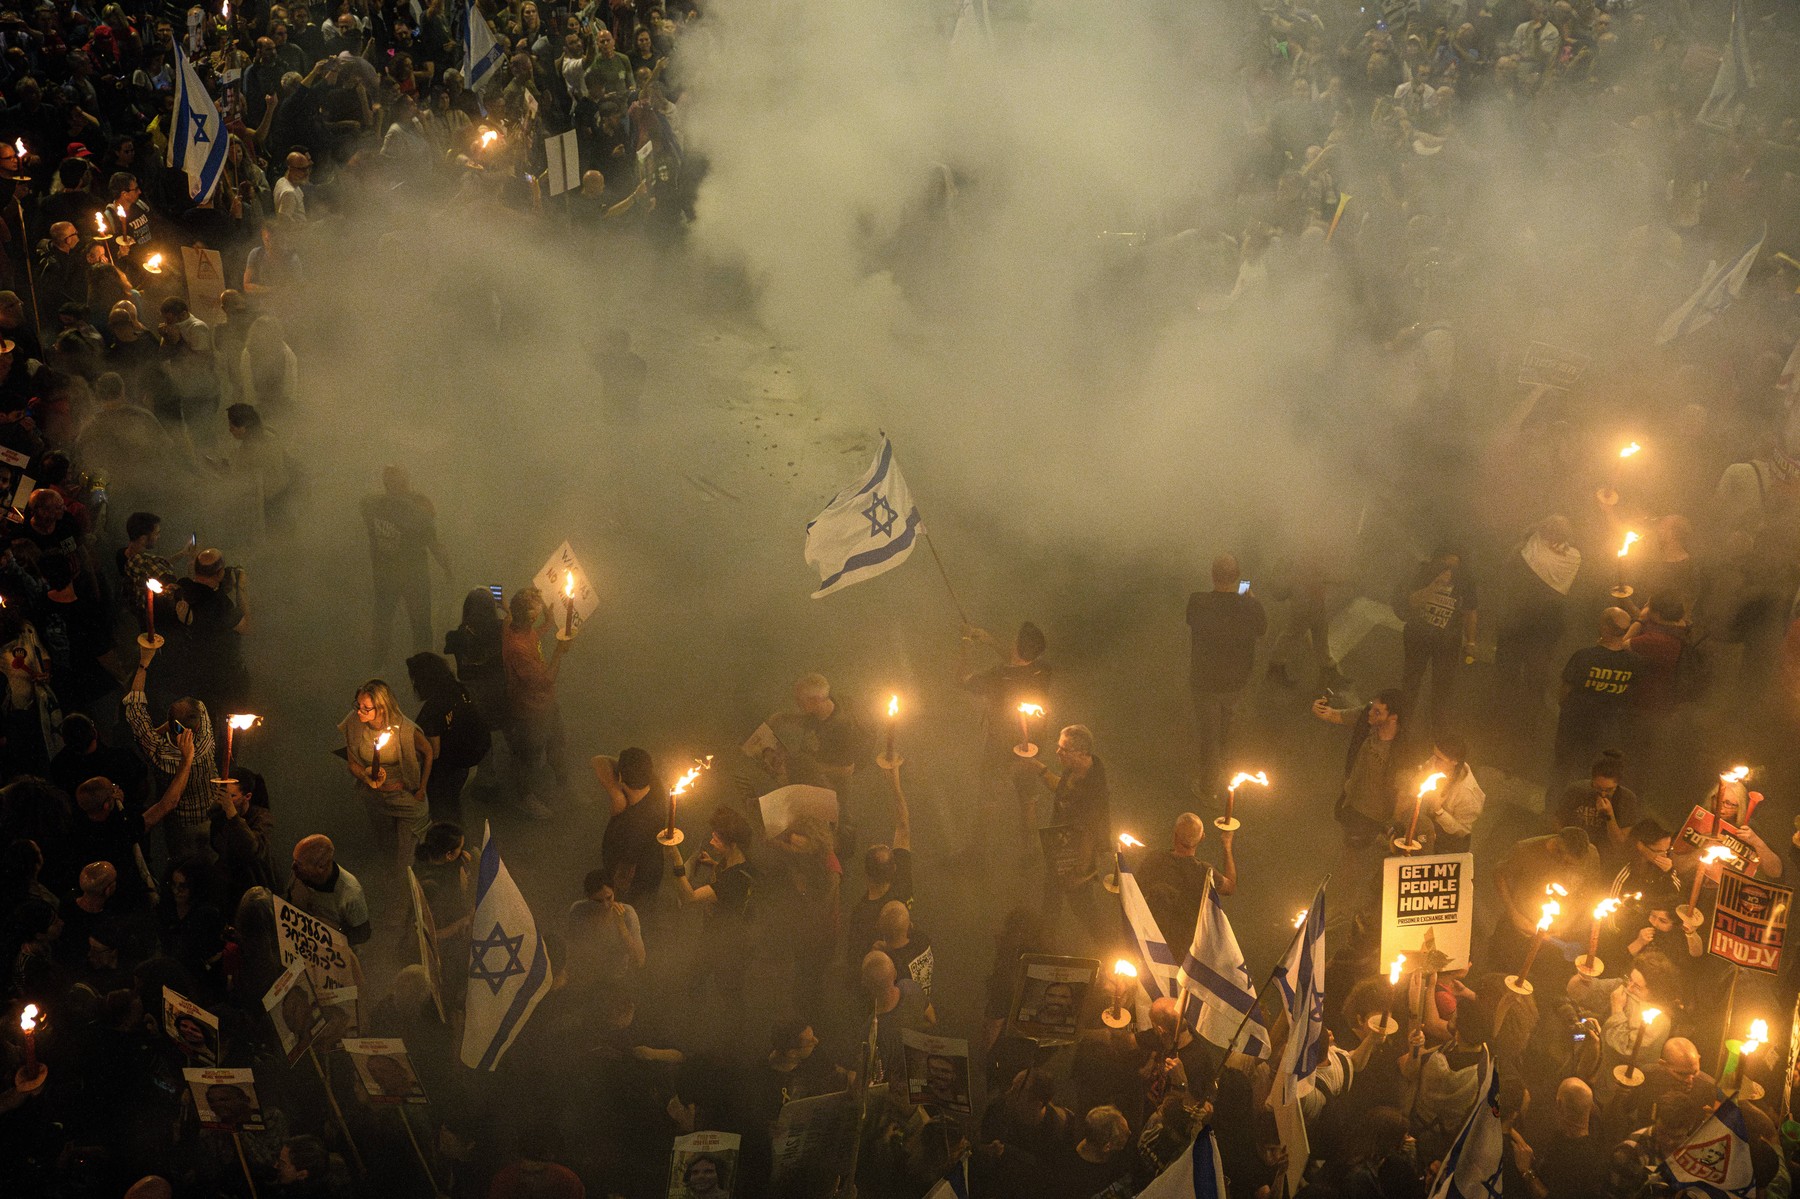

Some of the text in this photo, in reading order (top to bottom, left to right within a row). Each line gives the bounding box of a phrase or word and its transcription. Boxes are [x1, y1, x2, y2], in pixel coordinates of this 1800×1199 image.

[1589, 666, 1632, 681] הדחה
[1584, 679, 1628, 694] עכשיו
[1401, 864, 1457, 879] GET MY
[1401, 879, 1457, 894] PEOPLE
[1400, 894, 1456, 911] HOME!
[1398, 916, 1419, 924] PRISONER
[1420, 914, 1443, 922] EXCHANGE
[1717, 913, 1782, 946] בחירות
[1714, 932, 1778, 967] עכשיו!
